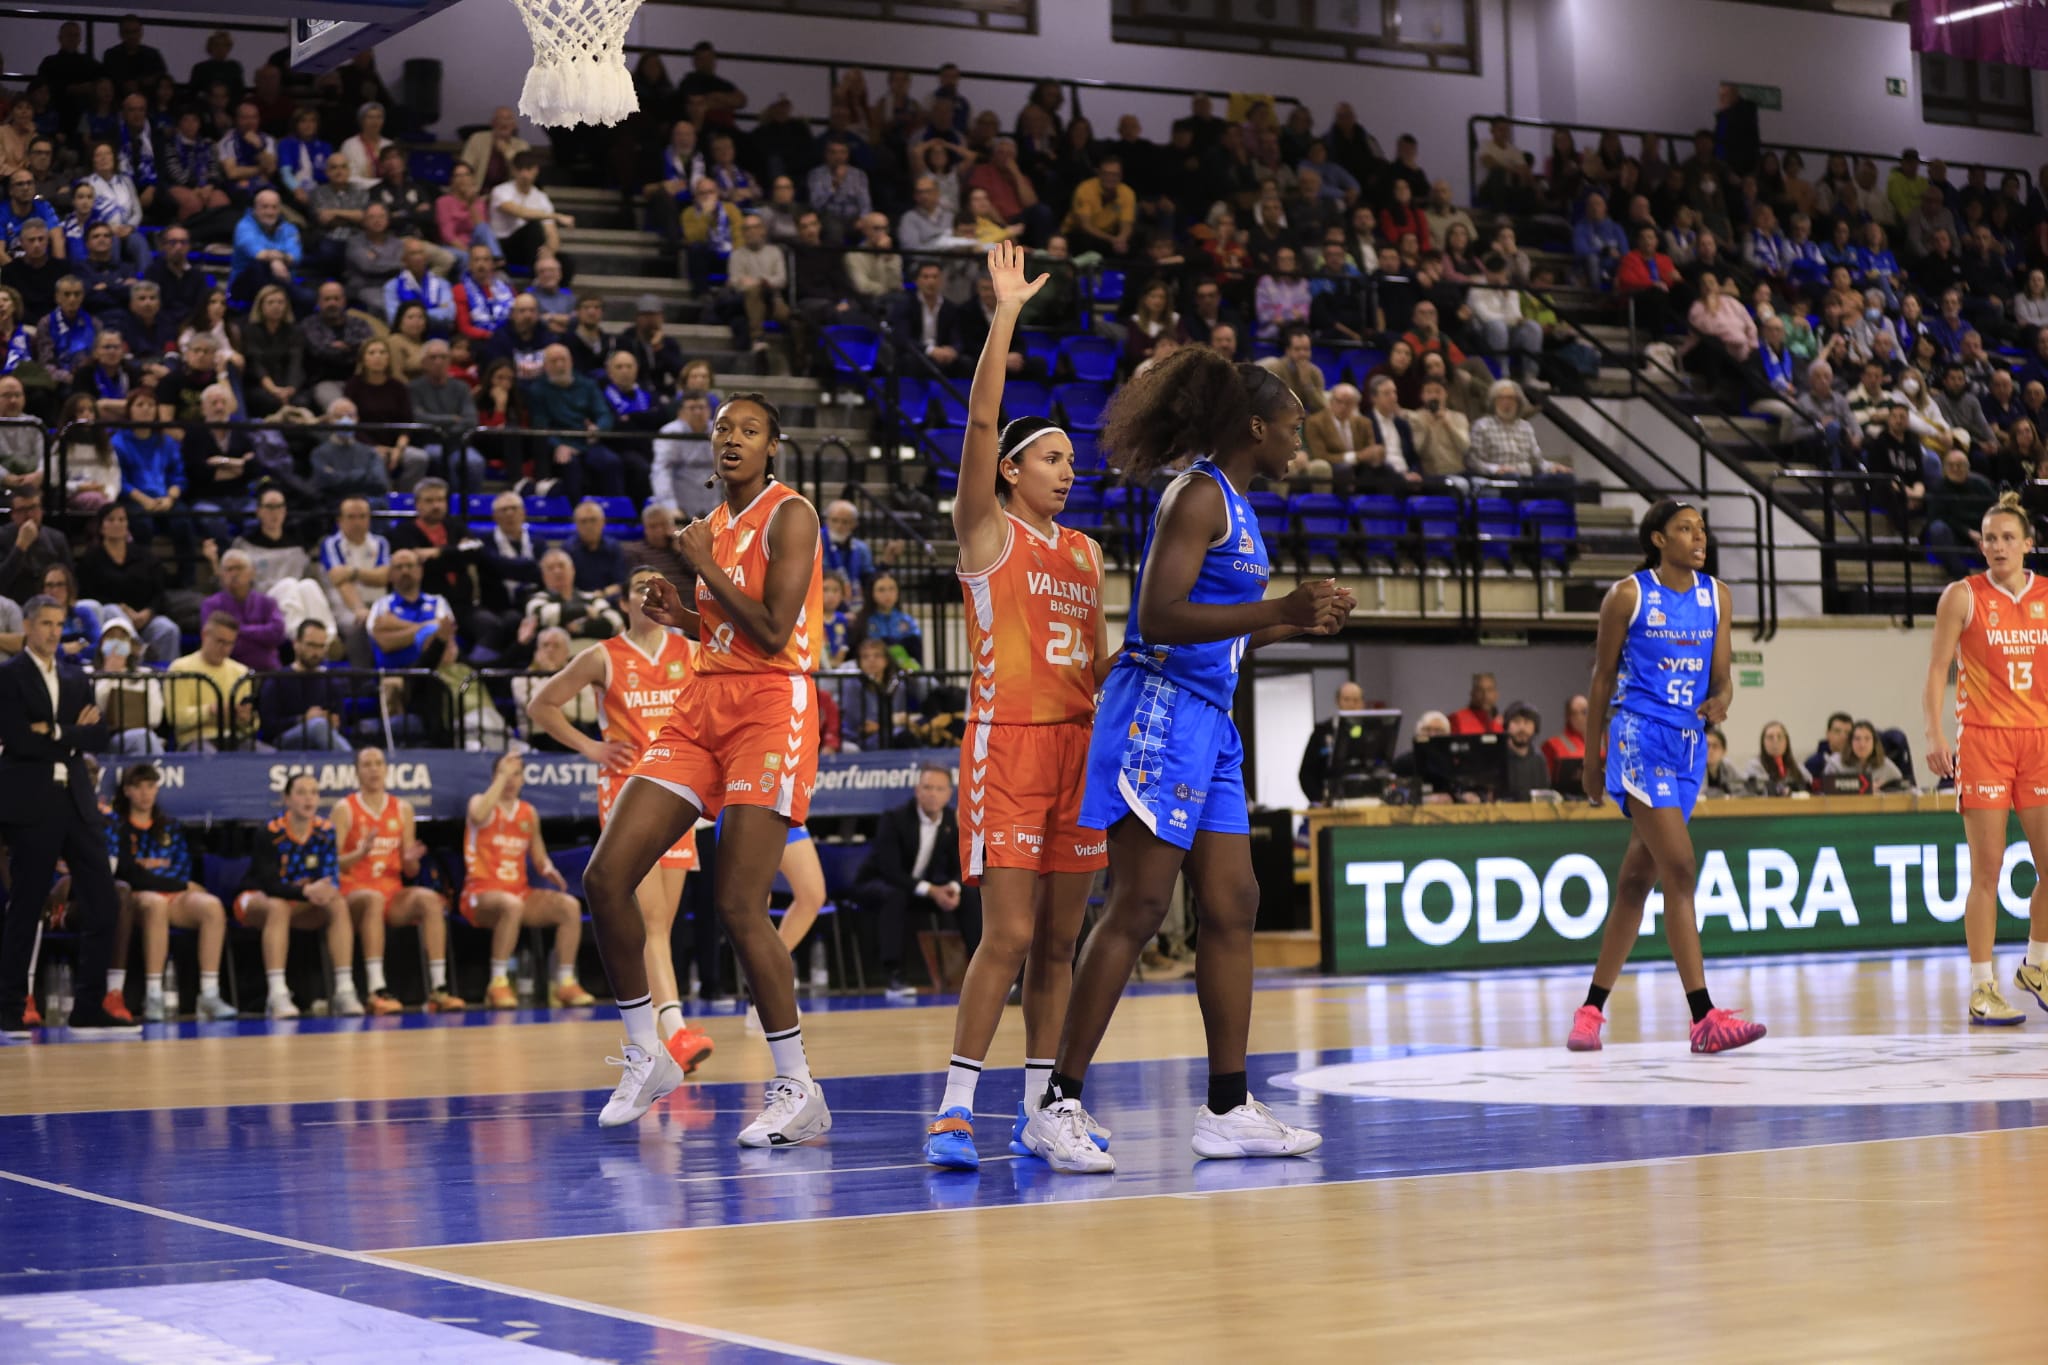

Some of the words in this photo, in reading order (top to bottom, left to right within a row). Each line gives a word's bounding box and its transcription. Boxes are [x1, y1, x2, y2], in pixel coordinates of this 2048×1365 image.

[1050, 600, 1089, 620] BASKET
[1645, 629, 1687, 639] CASTILLA
[1986, 628, 2048, 646] VALENCIA
[1046, 622, 1089, 670] 24
[2003, 645, 2036, 656] BASKET
[2007, 661, 2033, 690] 13
[1667, 679, 1696, 707] 55
[641, 706, 673, 718] BASKE
[1346, 853, 1609, 947] TODO
[1873, 843, 1970, 924] TU
